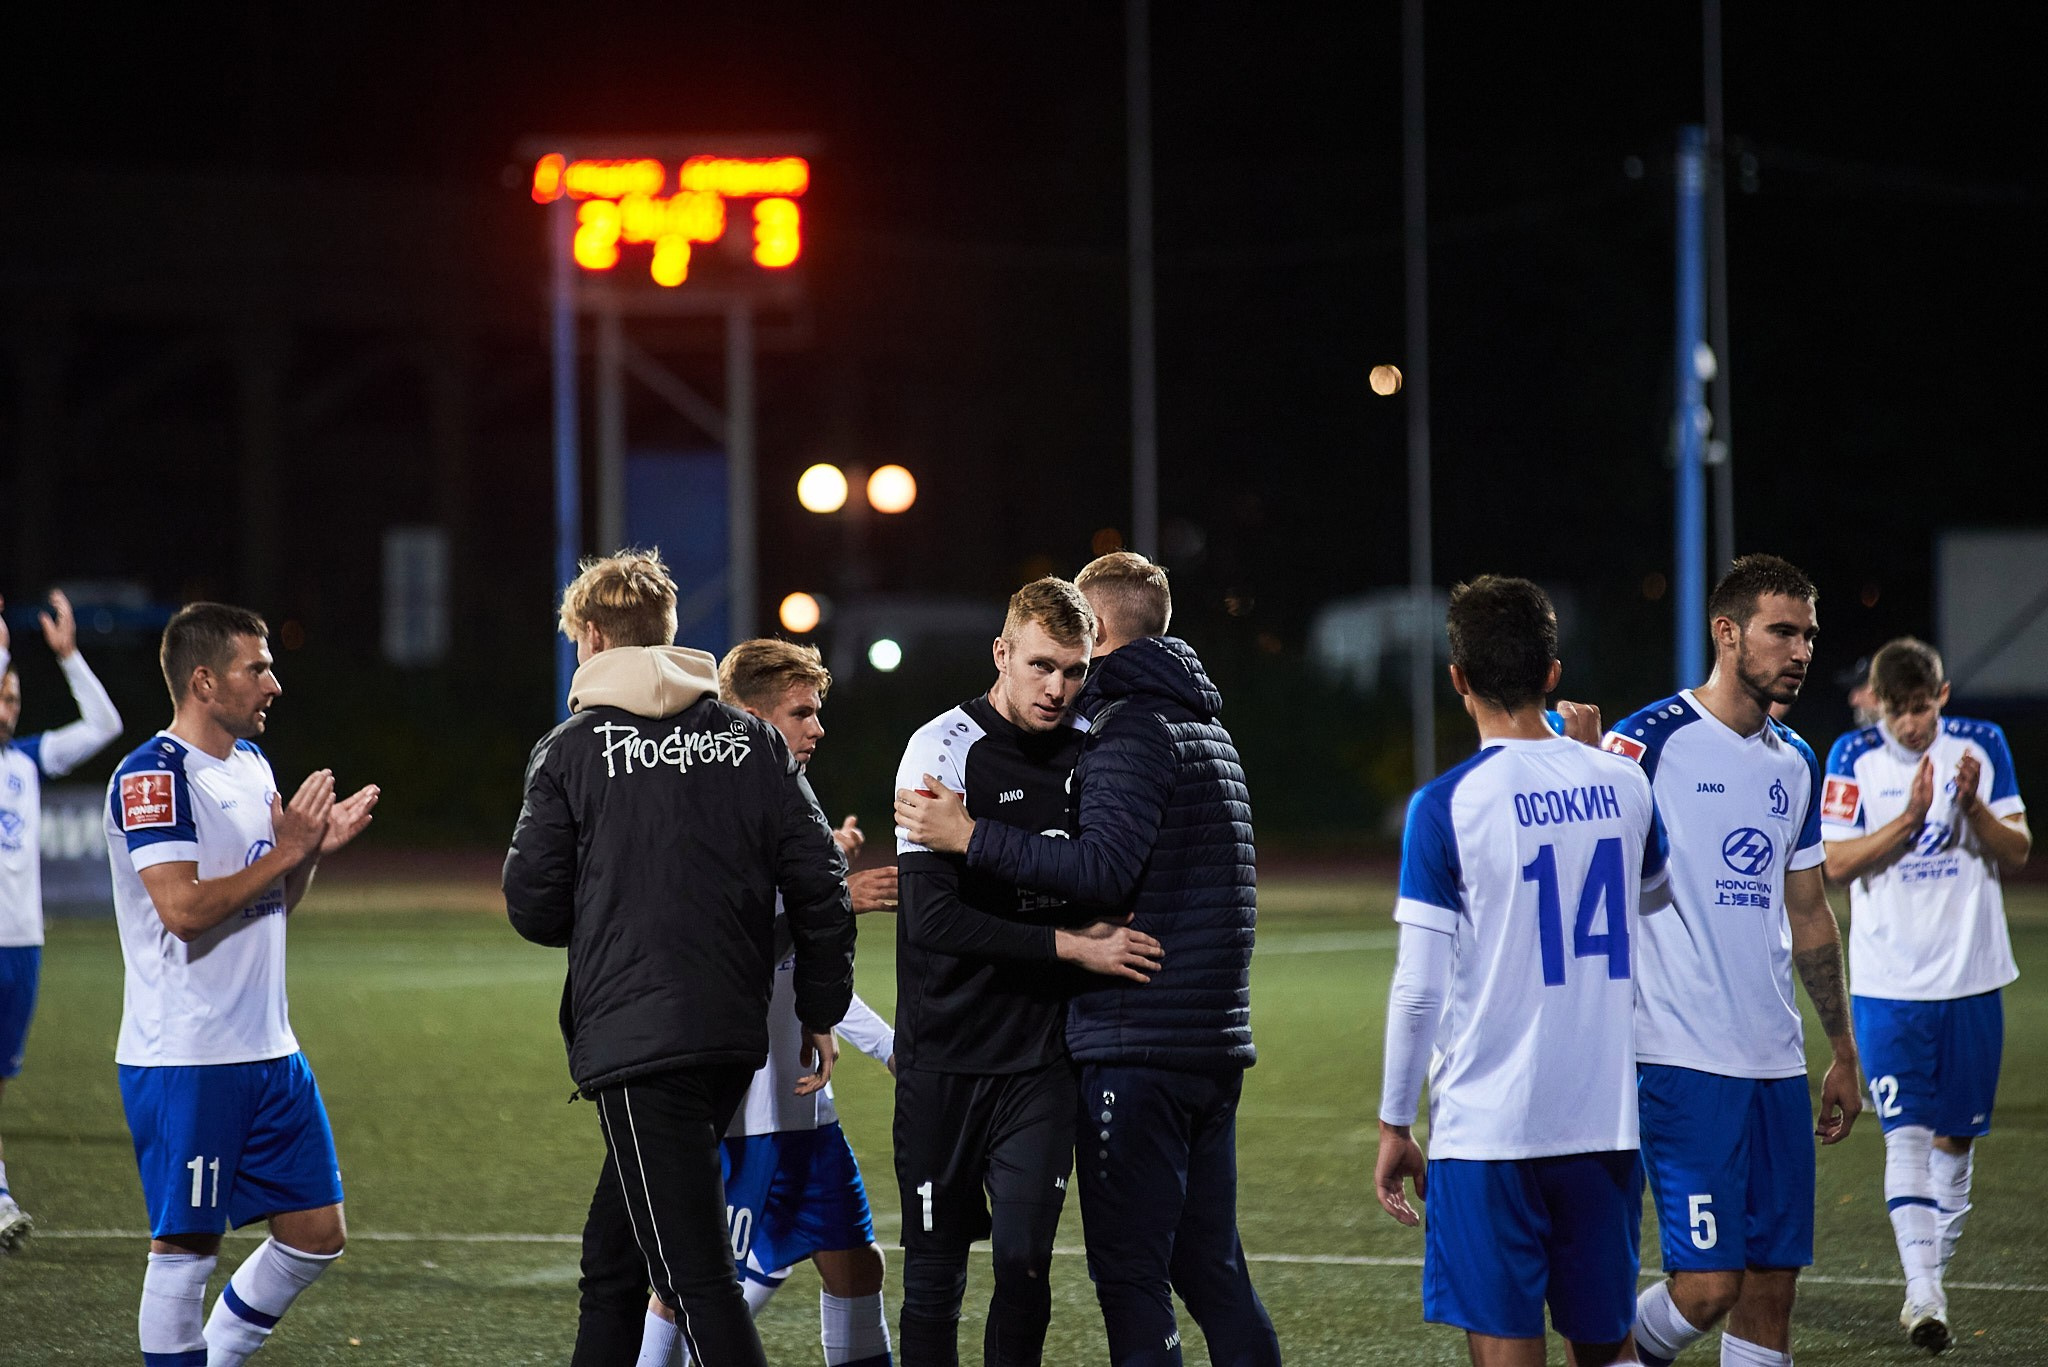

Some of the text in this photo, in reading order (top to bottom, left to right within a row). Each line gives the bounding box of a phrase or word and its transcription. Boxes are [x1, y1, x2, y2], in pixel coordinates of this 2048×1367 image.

[998, 788, 1024, 804] JAKO
[1514, 785, 1622, 828] ОСОКИН
[1696, 782, 1725, 793] JAKO
[127, 803, 169, 818] FONBET
[1522, 837, 1631, 987] 14
[1868, 1075, 1903, 1120] 12
[186, 1155, 220, 1208] 11
[916, 1181, 933, 1231] 1
[1688, 1194, 1718, 1250] 5
